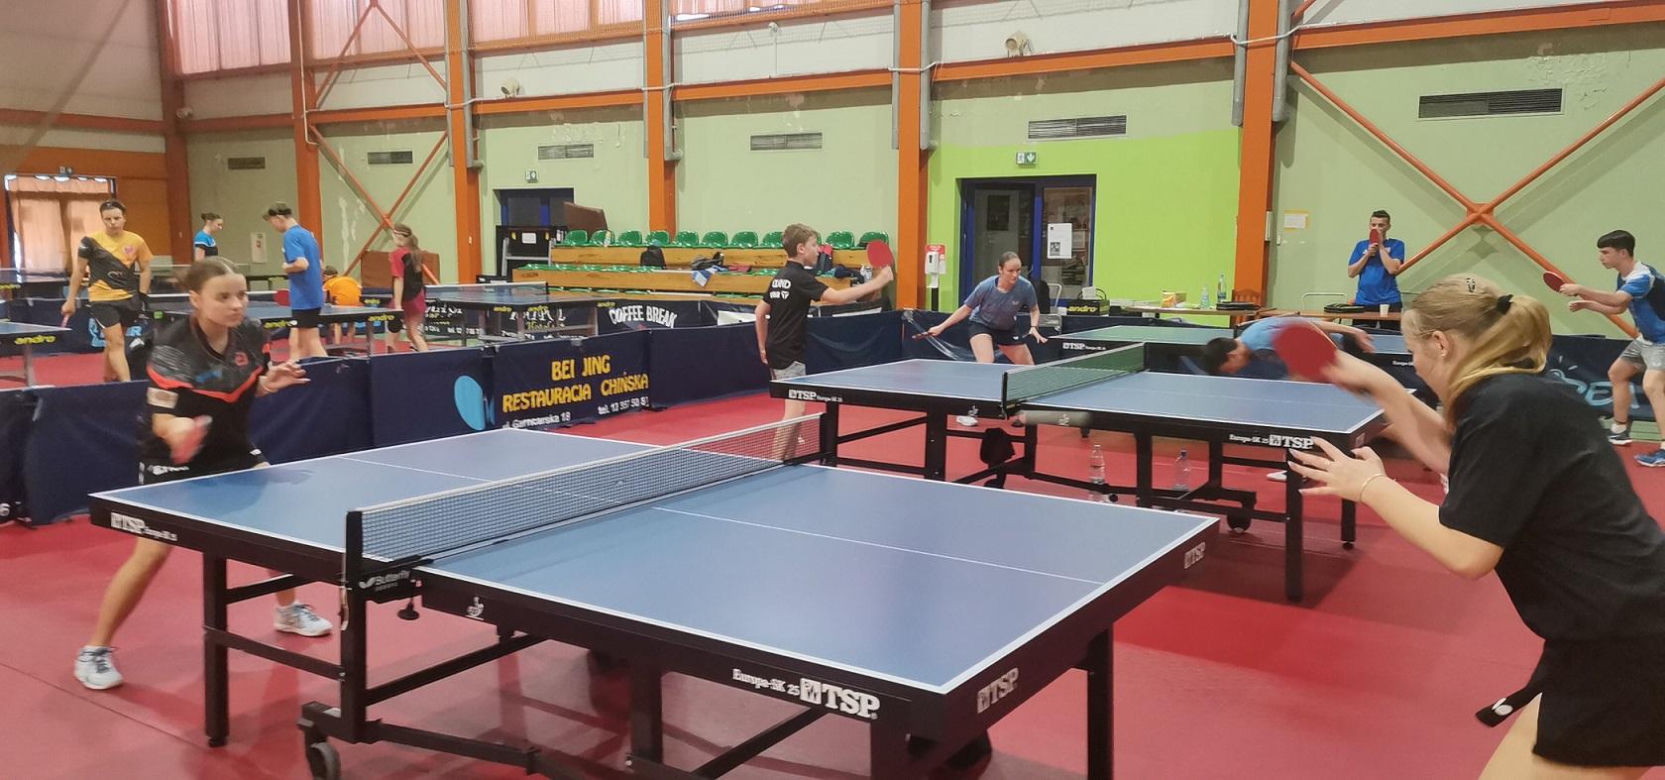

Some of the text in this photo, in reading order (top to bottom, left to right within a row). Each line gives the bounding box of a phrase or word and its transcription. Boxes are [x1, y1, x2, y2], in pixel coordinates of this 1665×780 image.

[609, 304, 678, 329] COFFEE BREAK
[14, 334, 56, 345] andro
[551, 354, 611, 382] BEI JING
[502, 384, 592, 413] RESTAURACJA
[797, 390, 817, 401] TSP
[1282, 436, 1314, 450] TSP
[990, 667, 1019, 705] TSP
[821, 683, 881, 719] TSP
